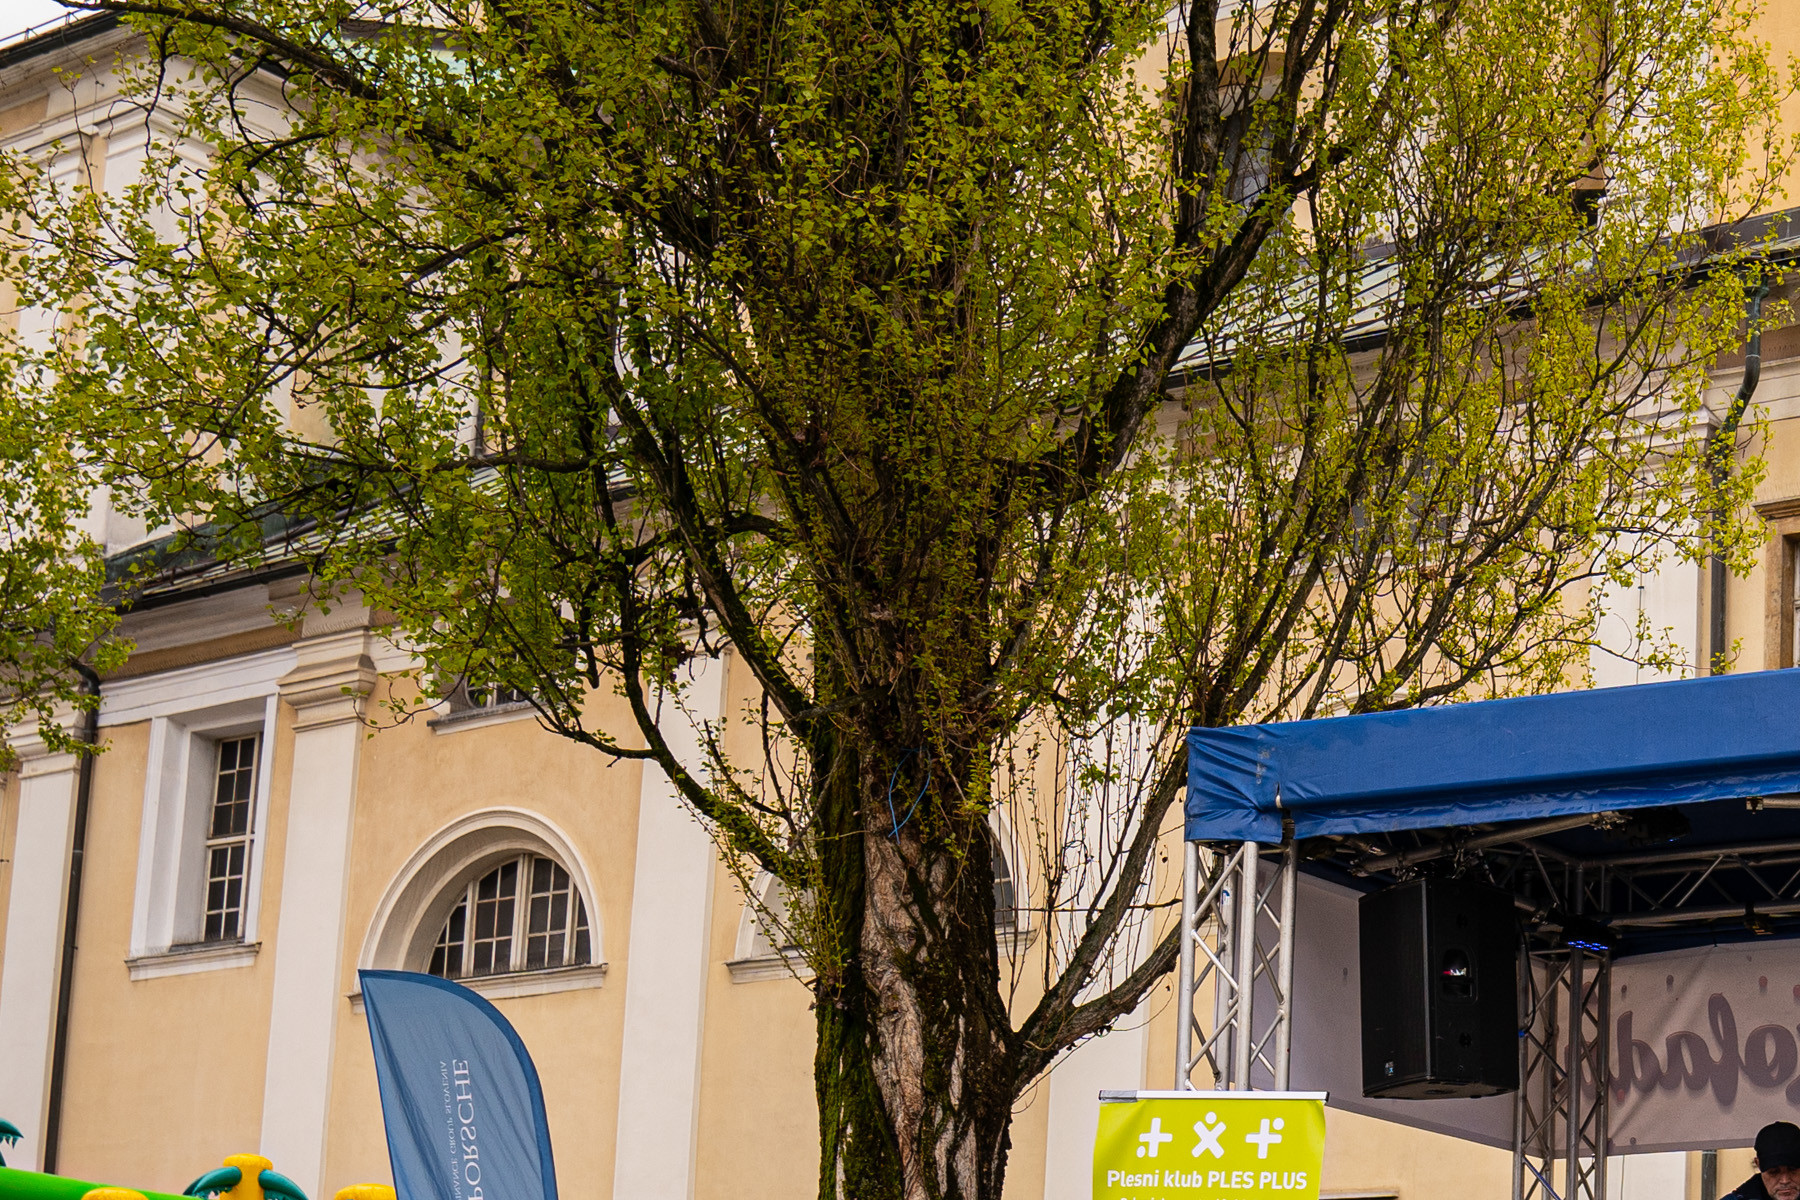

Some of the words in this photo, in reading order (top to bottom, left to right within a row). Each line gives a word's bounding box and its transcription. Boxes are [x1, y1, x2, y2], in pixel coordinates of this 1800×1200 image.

[1107, 1169, 1160, 1189] Plesni
[1164, 1170, 1203, 1189] klub
[1207, 1171, 1255, 1190] PLES
[1260, 1172, 1307, 1190] PLUS
